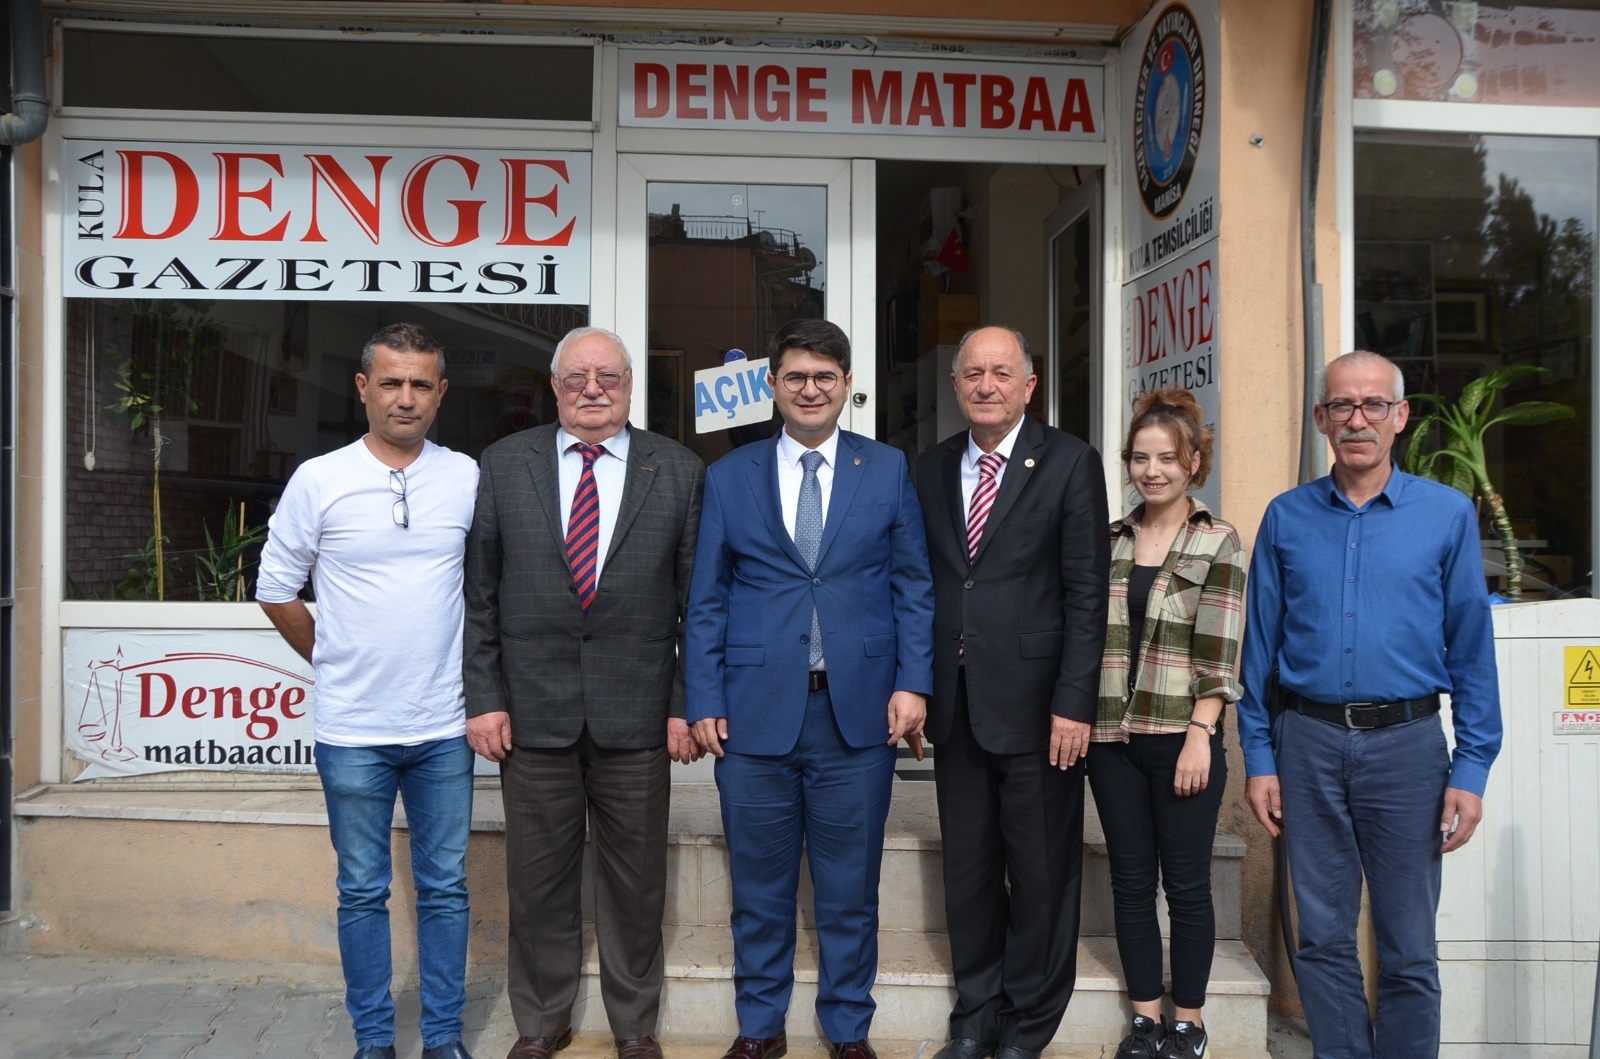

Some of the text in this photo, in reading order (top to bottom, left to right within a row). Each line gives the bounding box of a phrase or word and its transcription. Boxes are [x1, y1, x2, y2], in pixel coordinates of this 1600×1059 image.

[1147, 37, 1158, 62] VE
[1157, 11, 1199, 56] YAYINCILAR
[634, 62, 1096, 133] DENGE MATBAA
[77, 148, 105, 241] KULA
[112, 149, 577, 247] DENGE
[1153, 183, 1182, 214] MANİSA
[1129, 196, 1213, 275] KULA TEMSİLCİLİĞİ
[74, 255, 561, 296] GAZETESİ
[1131, 258, 1214, 369] DENGE
[695, 365, 774, 419] AÇIK
[135, 672, 306, 741] Denge
[144, 739, 316, 765] matbaacılı
